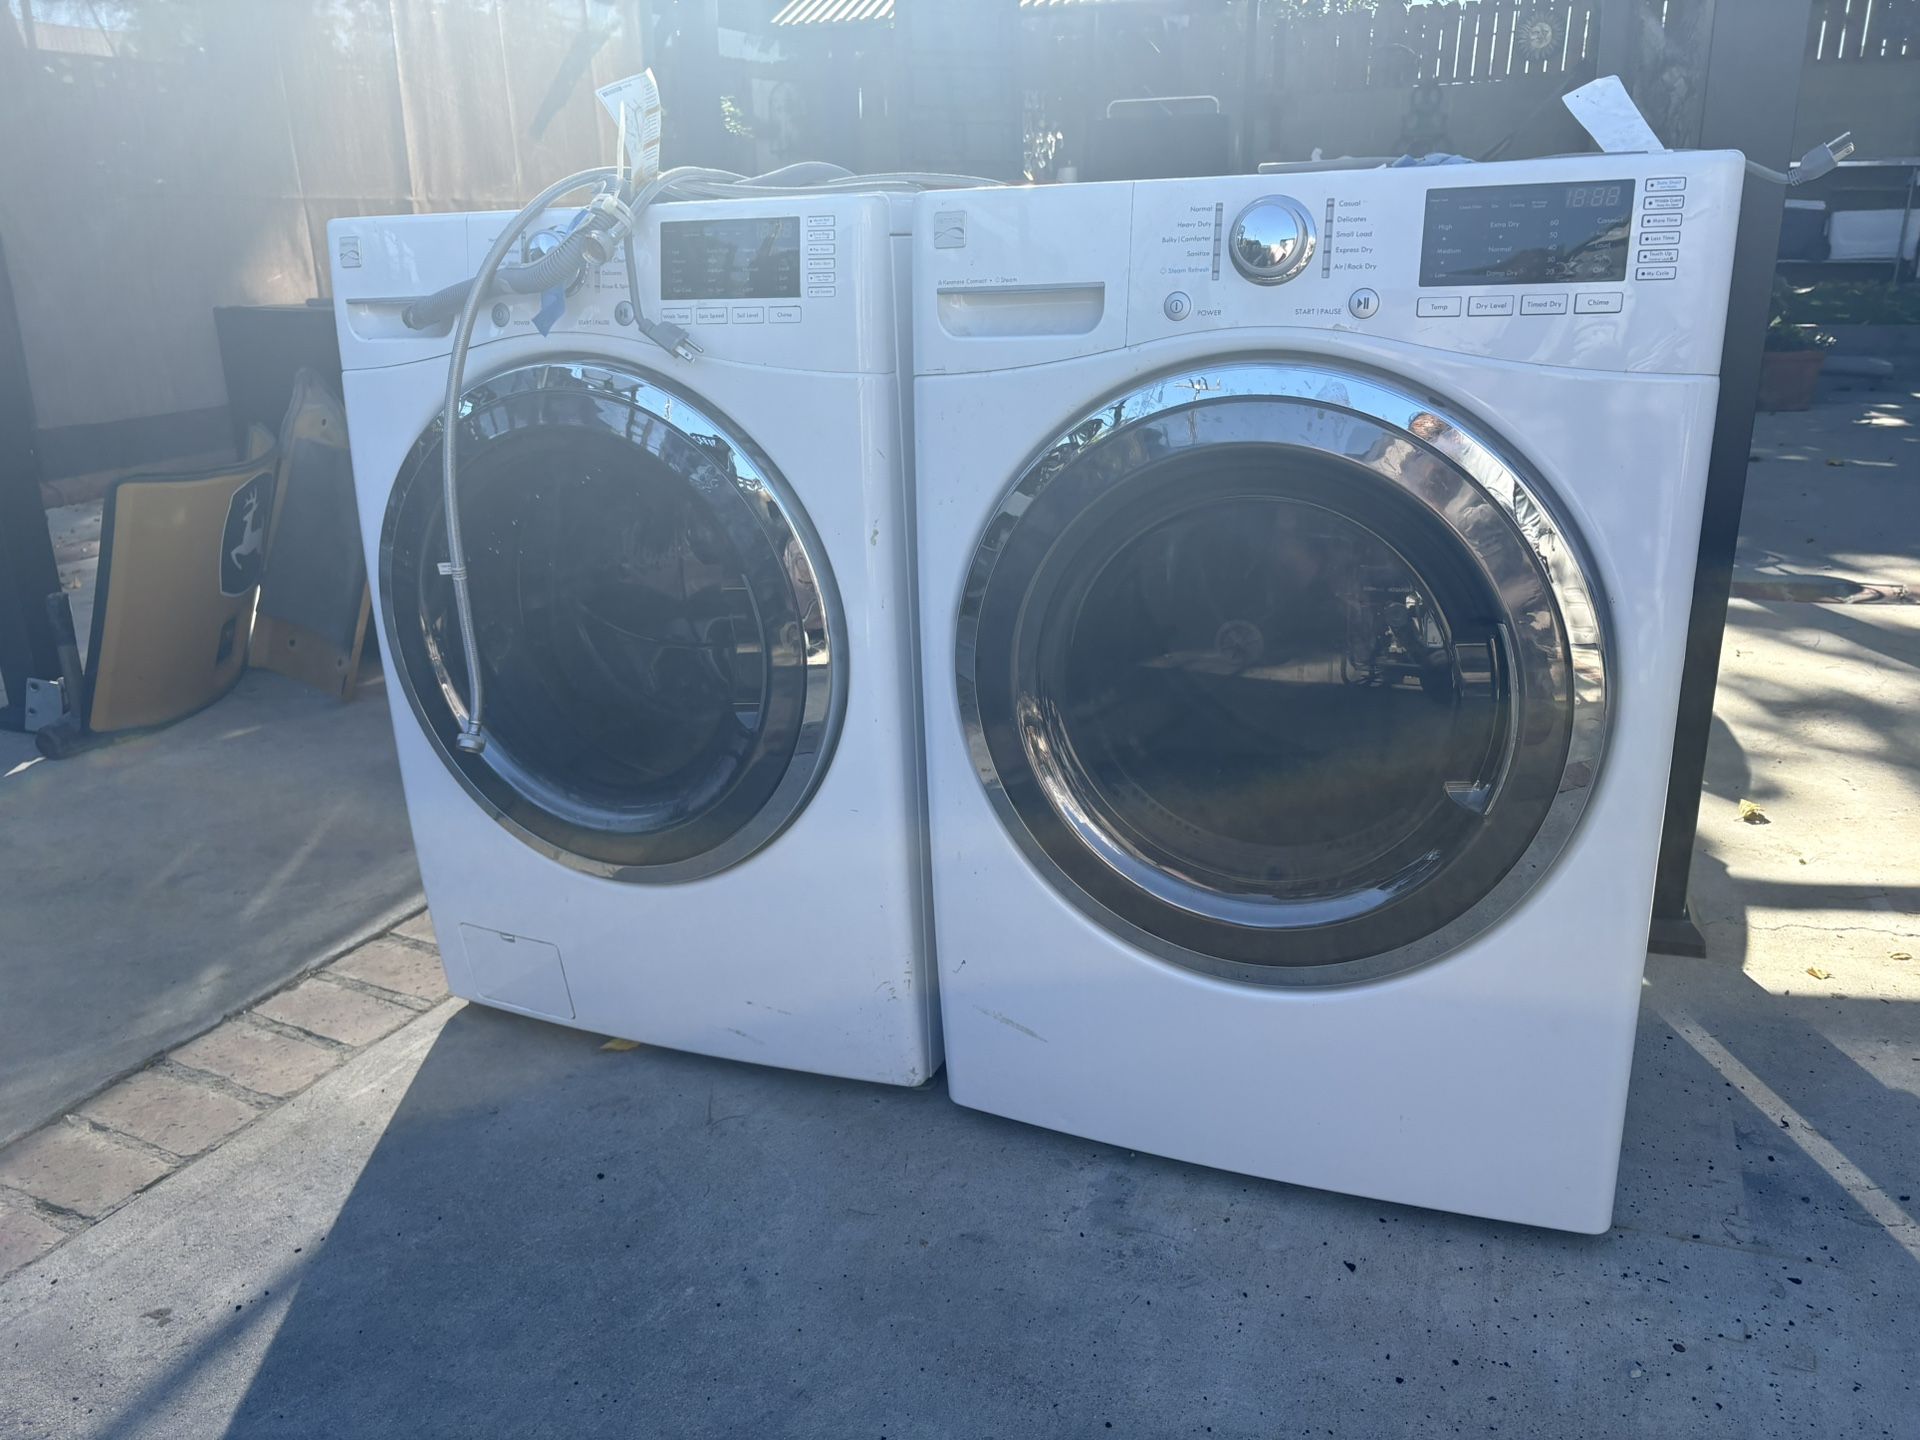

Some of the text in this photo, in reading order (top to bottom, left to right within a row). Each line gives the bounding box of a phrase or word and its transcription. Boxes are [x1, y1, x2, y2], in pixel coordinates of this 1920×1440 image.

[1177, 220, 1212, 229] Heavy Duty
[1508, 221, 1520, 229] Dry
[1161, 236, 1177, 244] Bulky
[1180, 235, 1211, 243] Comforter
[1335, 246, 1373, 254] Express Dry
[1364, 263, 1377, 271] Dry
[1431, 303, 1448, 311] Temp
[1476, 302, 1488, 310] Dry
[1549, 300, 1562, 309] Dry
[709, 312, 725, 320] Speed
[1295, 308, 1315, 316] START
